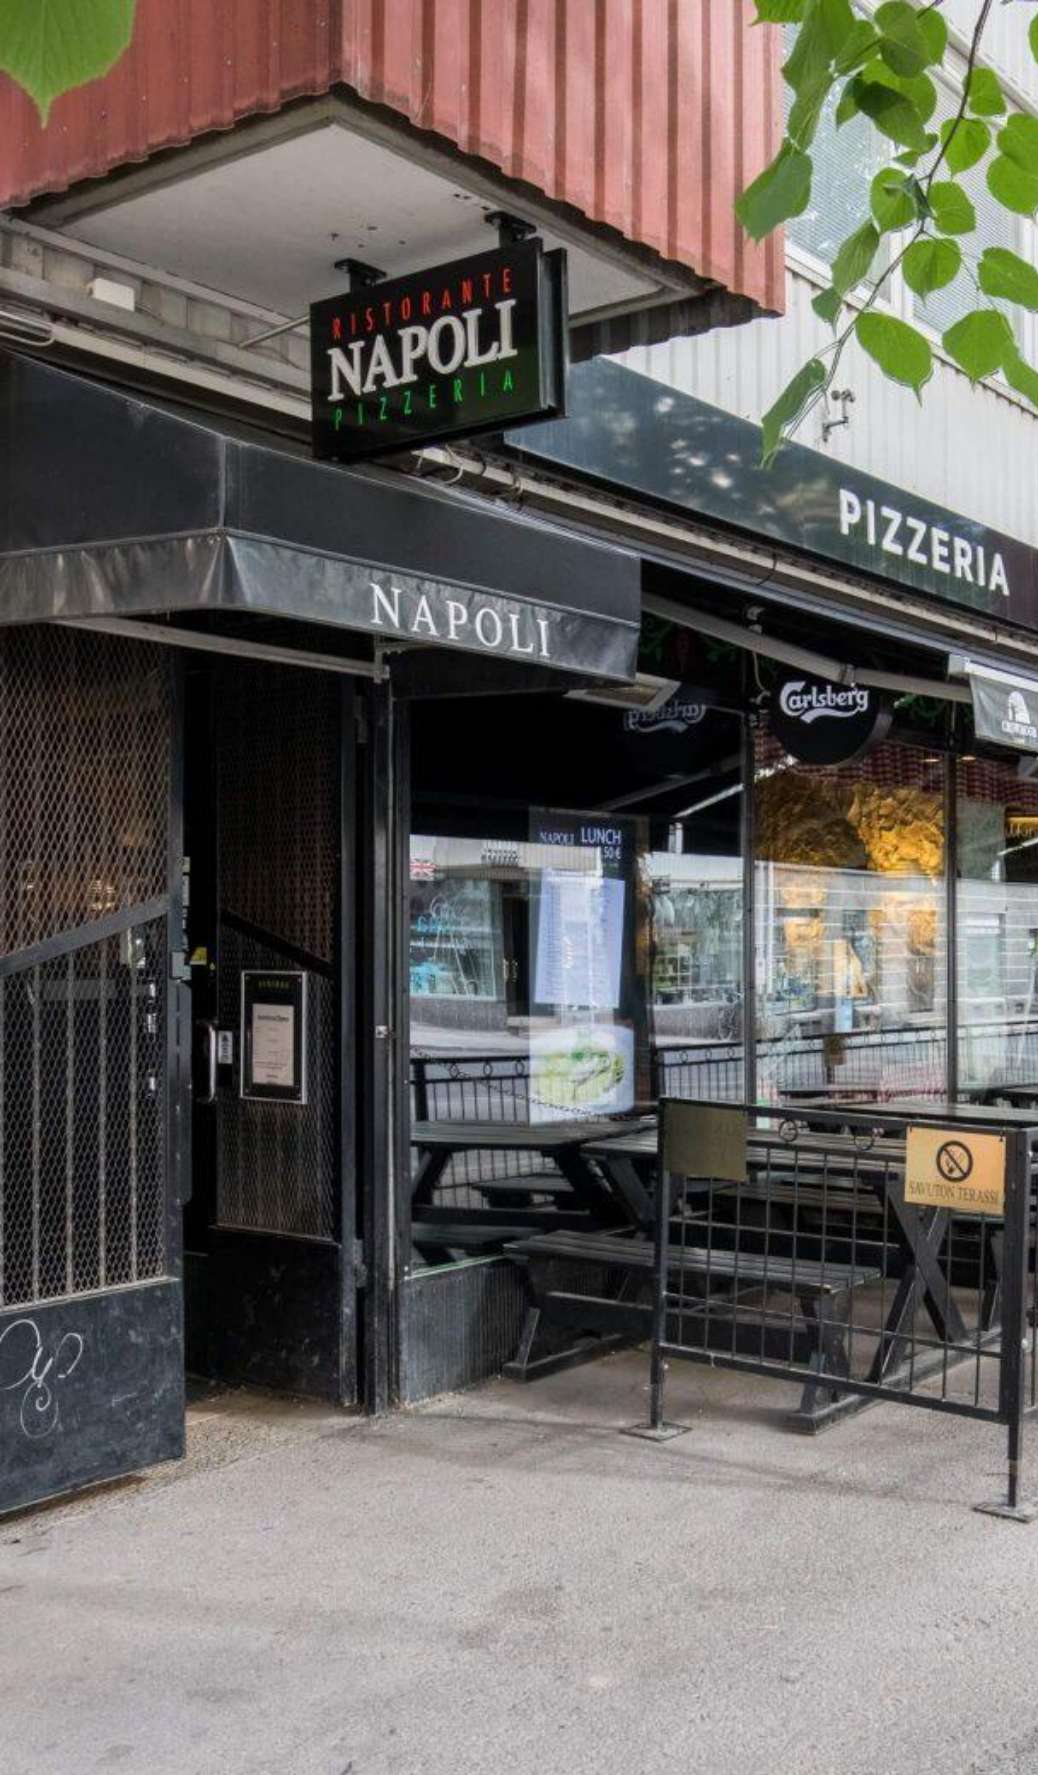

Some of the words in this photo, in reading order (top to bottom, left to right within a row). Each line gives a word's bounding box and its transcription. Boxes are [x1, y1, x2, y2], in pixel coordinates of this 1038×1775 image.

[331, 268, 513, 340] RISTORANTE
[327, 298, 519, 402] NAPOLI
[332, 369, 515, 431] PIZZERIA
[838, 489, 1010, 596] PIZZERIA
[370, 583, 550, 657] NAPOLI
[780, 680, 870, 724] Carlsberg
[581, 827, 622, 845] LUNCH
